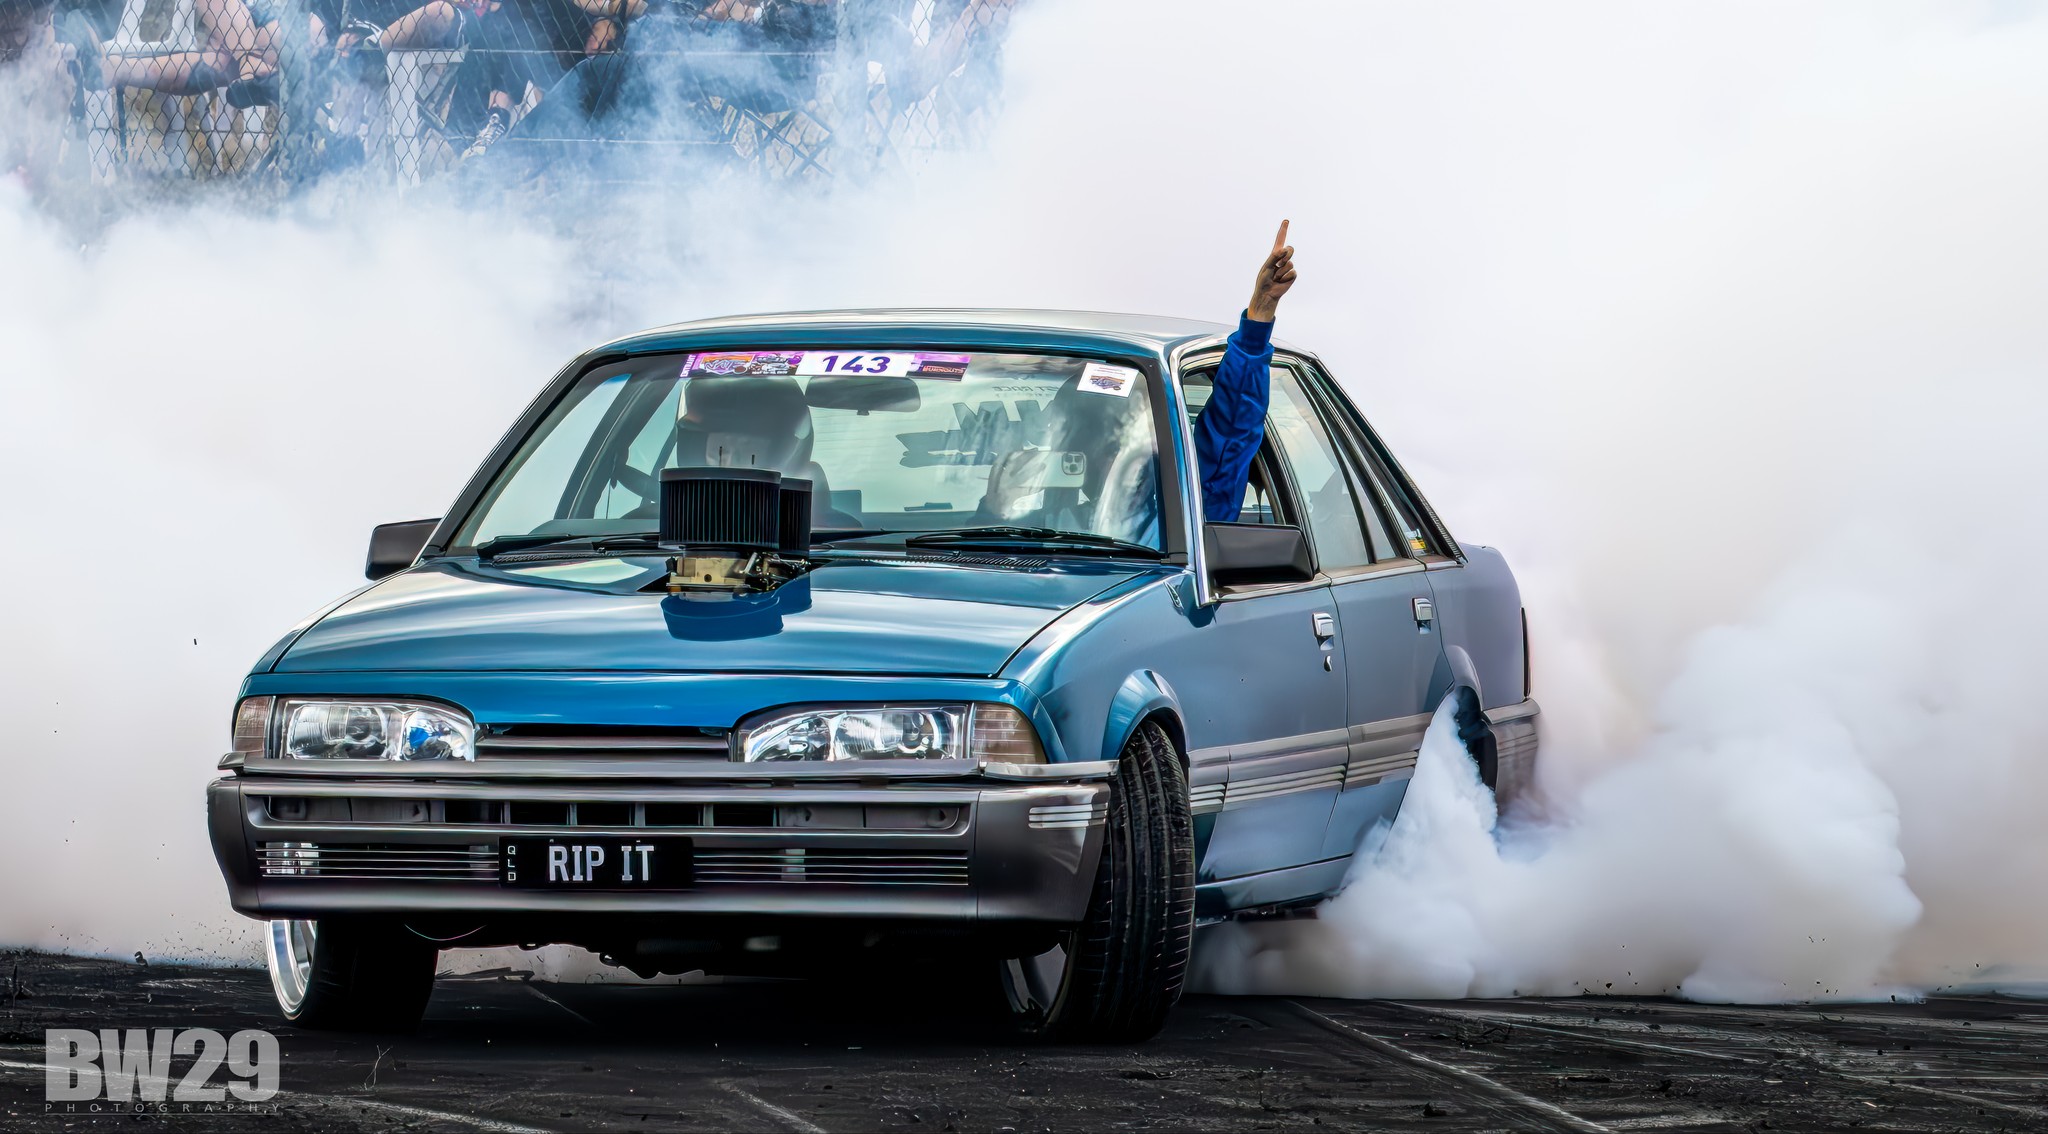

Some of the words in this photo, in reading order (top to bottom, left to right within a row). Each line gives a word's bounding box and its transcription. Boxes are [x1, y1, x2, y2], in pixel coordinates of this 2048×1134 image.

[822, 355, 891, 374] 143
[507, 845, 517, 882] QLD
[548, 845, 605, 882] RIP
[620, 845, 655, 882] IT
